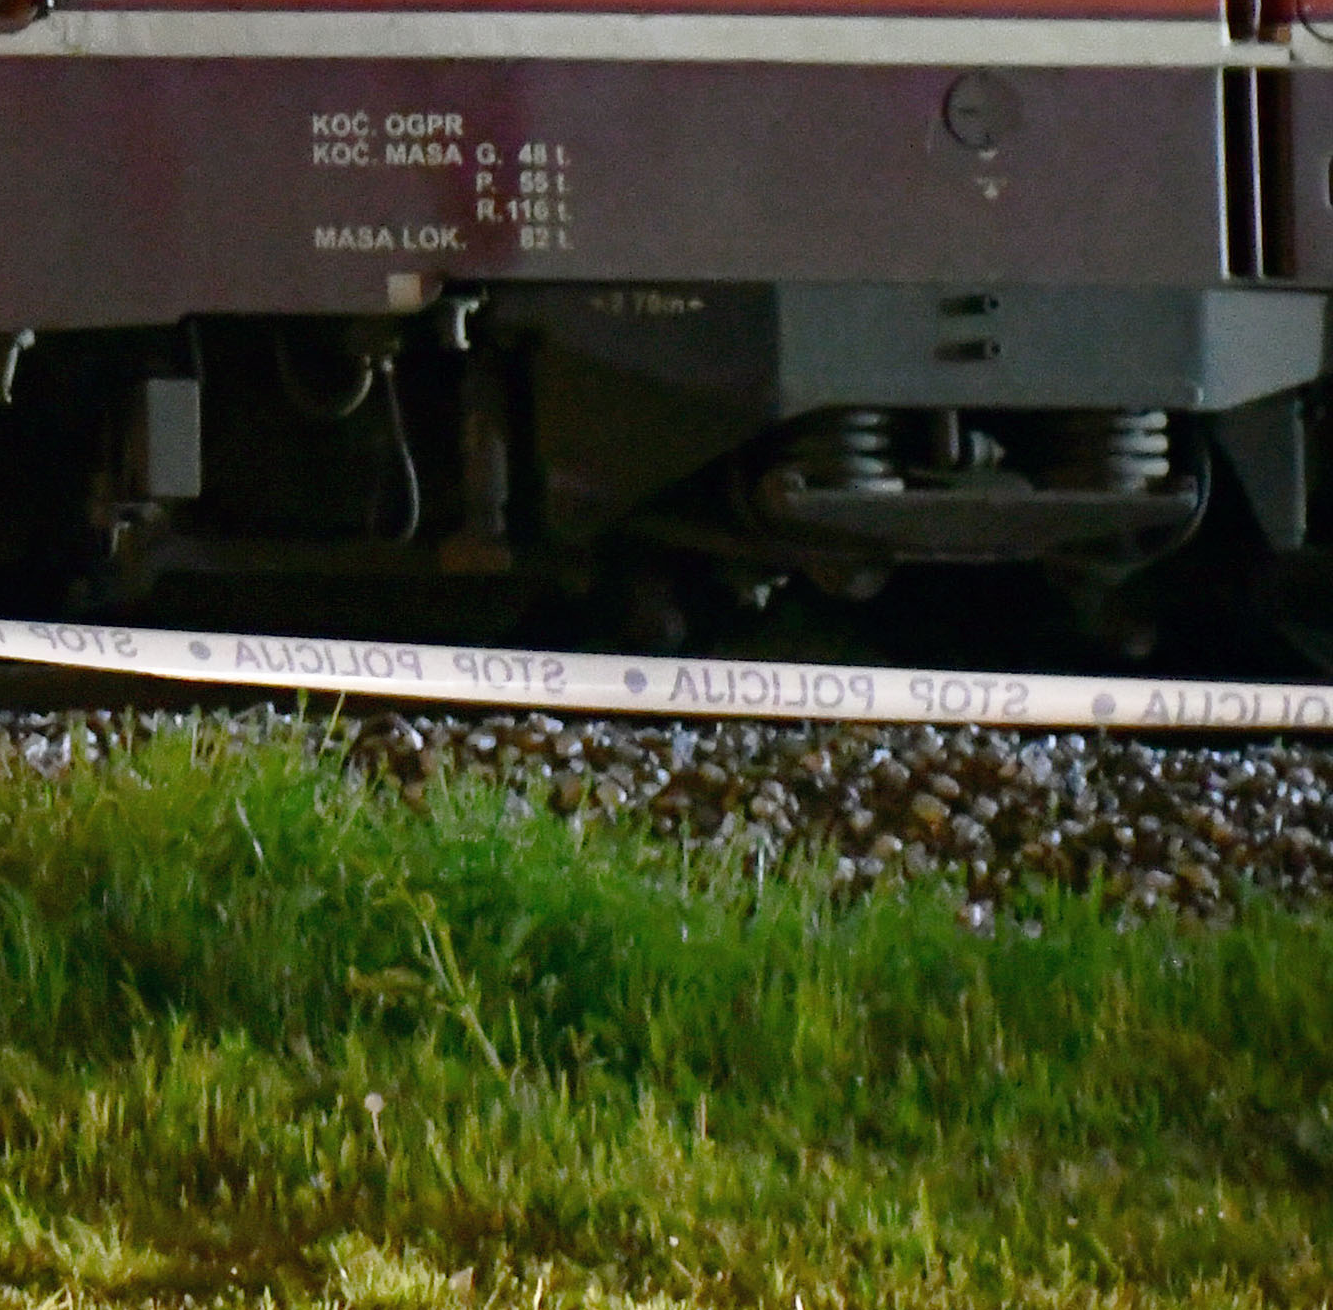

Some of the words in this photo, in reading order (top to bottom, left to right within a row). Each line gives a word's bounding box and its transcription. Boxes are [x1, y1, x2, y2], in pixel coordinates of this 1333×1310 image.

[385, 113, 463, 137] OGPR
[385, 142, 462, 166] MASA
[314, 227, 393, 250] MASA
